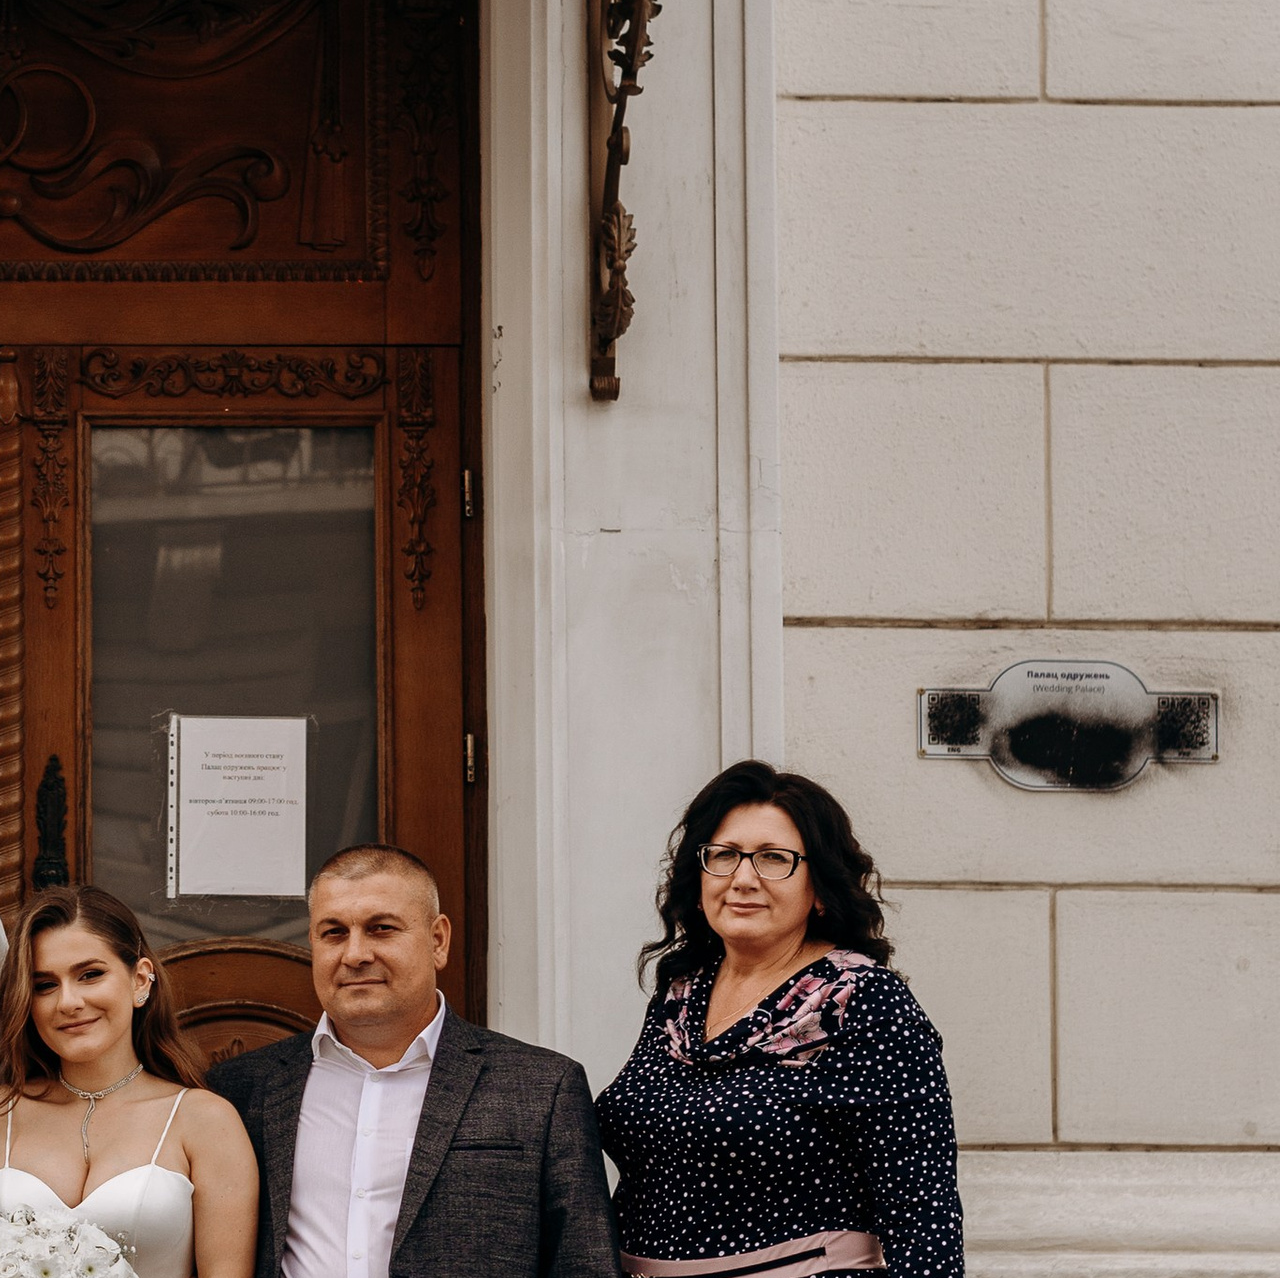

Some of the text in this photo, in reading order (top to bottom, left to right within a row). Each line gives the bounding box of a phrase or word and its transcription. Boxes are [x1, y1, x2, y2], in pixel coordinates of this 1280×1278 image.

[1027, 671, 1110, 681] Палац одружень
[1032, 684, 1105, 694] (Wedding Palace)
